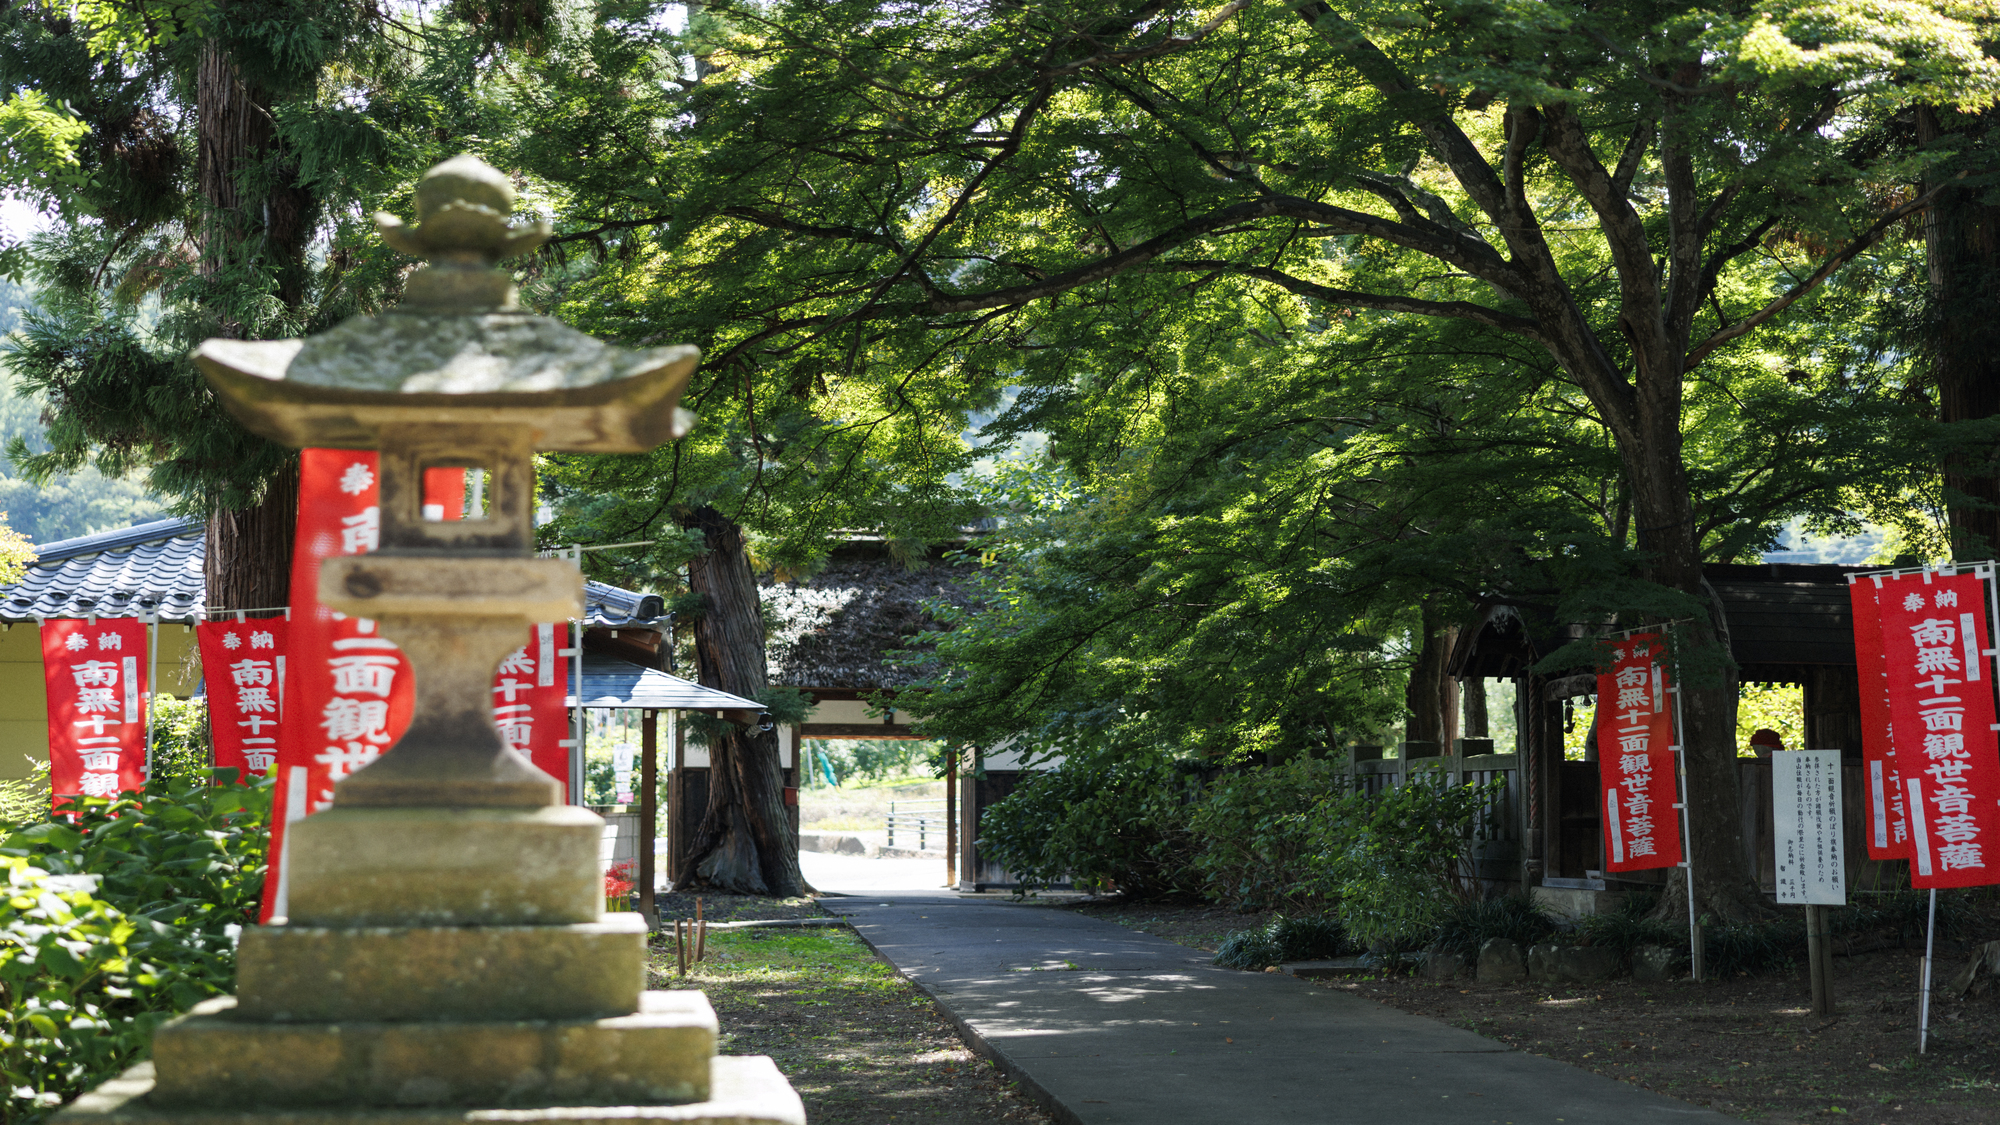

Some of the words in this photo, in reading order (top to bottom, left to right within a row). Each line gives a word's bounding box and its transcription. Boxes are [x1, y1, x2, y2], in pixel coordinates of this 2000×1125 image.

[1903, 590, 1958, 611] 奉納
[66, 632, 122, 651] 奉納
[222, 631, 274, 650] 奉納
[230, 659, 278, 781] 南無十一面
[1909, 618, 1986, 871] 南無十一面観世音菩薩
[1615, 666, 1657, 859] 南無十一面観世音菩薩
